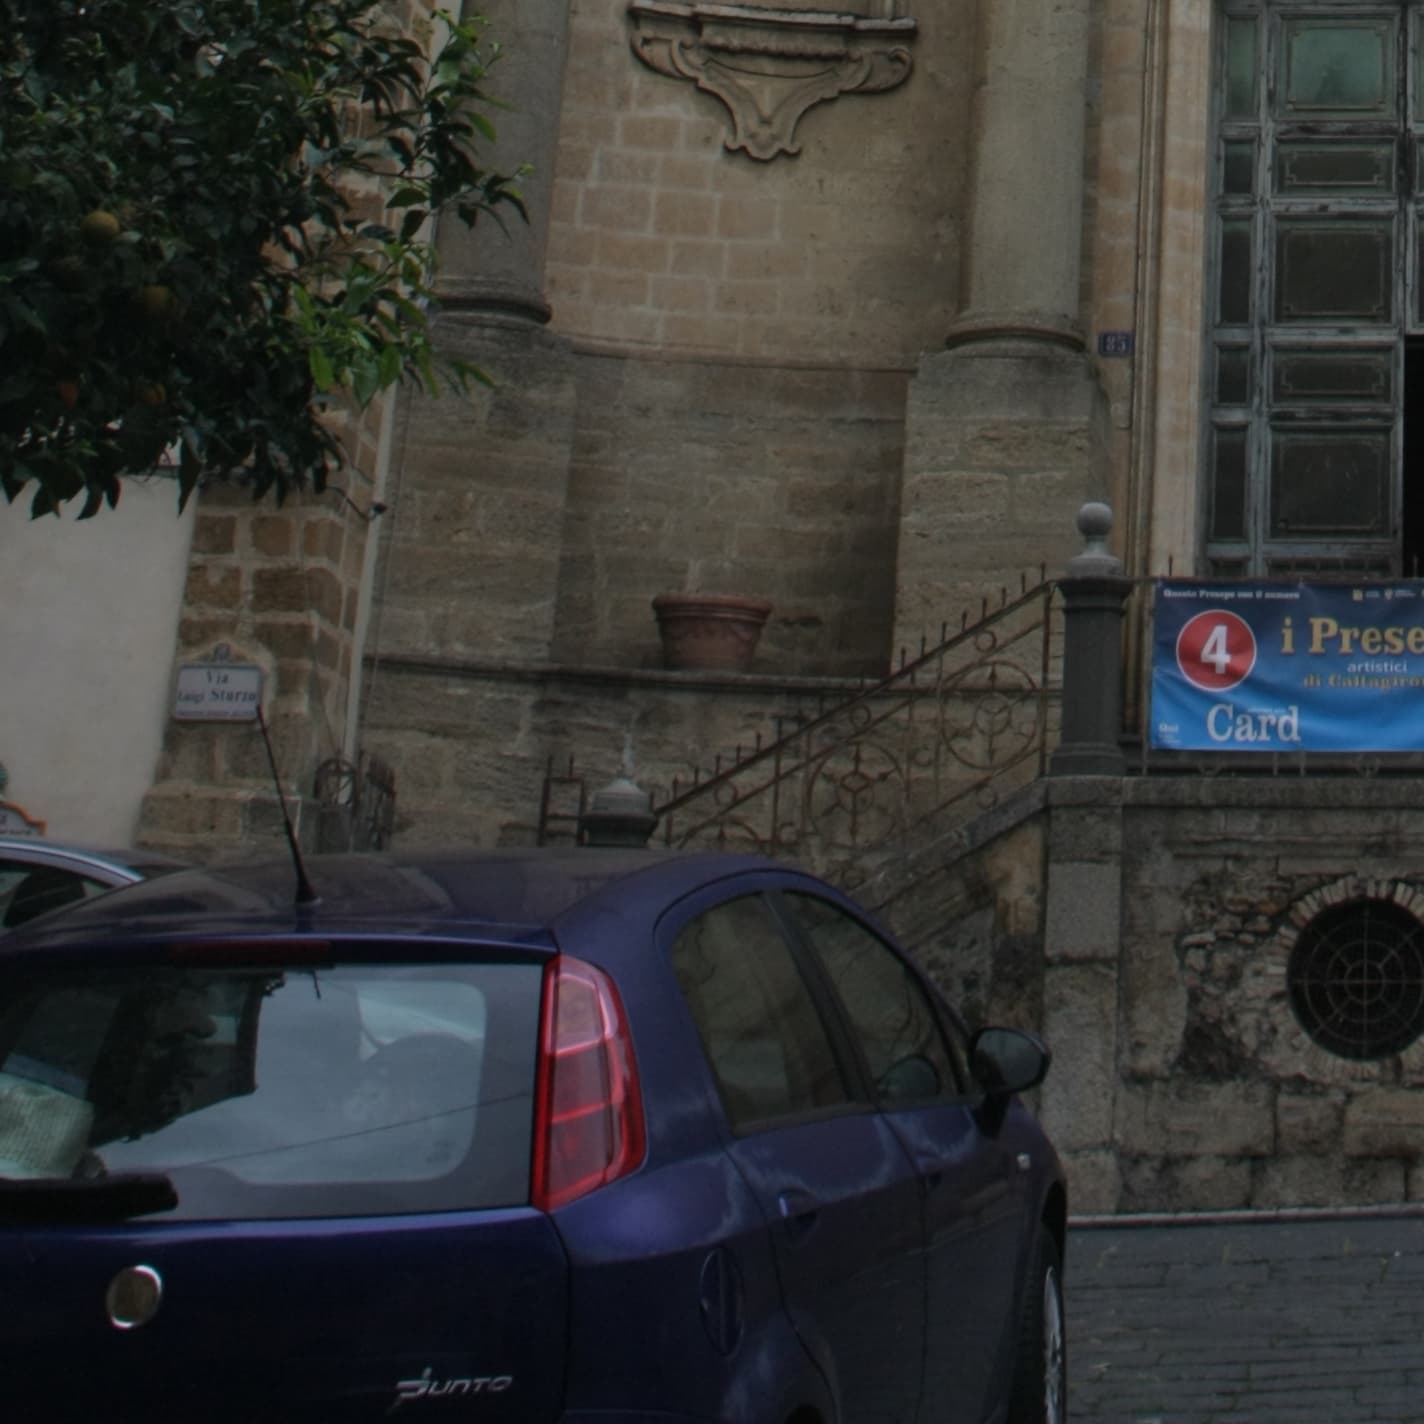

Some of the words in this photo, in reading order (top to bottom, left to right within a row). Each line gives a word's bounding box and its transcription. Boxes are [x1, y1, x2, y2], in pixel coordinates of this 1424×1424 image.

[1280, 618, 1295, 655] i
[1200, 624, 1231, 675] 4
[1346, 660, 1408, 674] artistici
[206, 671, 230, 685] Via
[1303, 673, 1321, 689] di
[208, 688, 257, 703] Sturzo
[1206, 703, 1302, 743] Card
